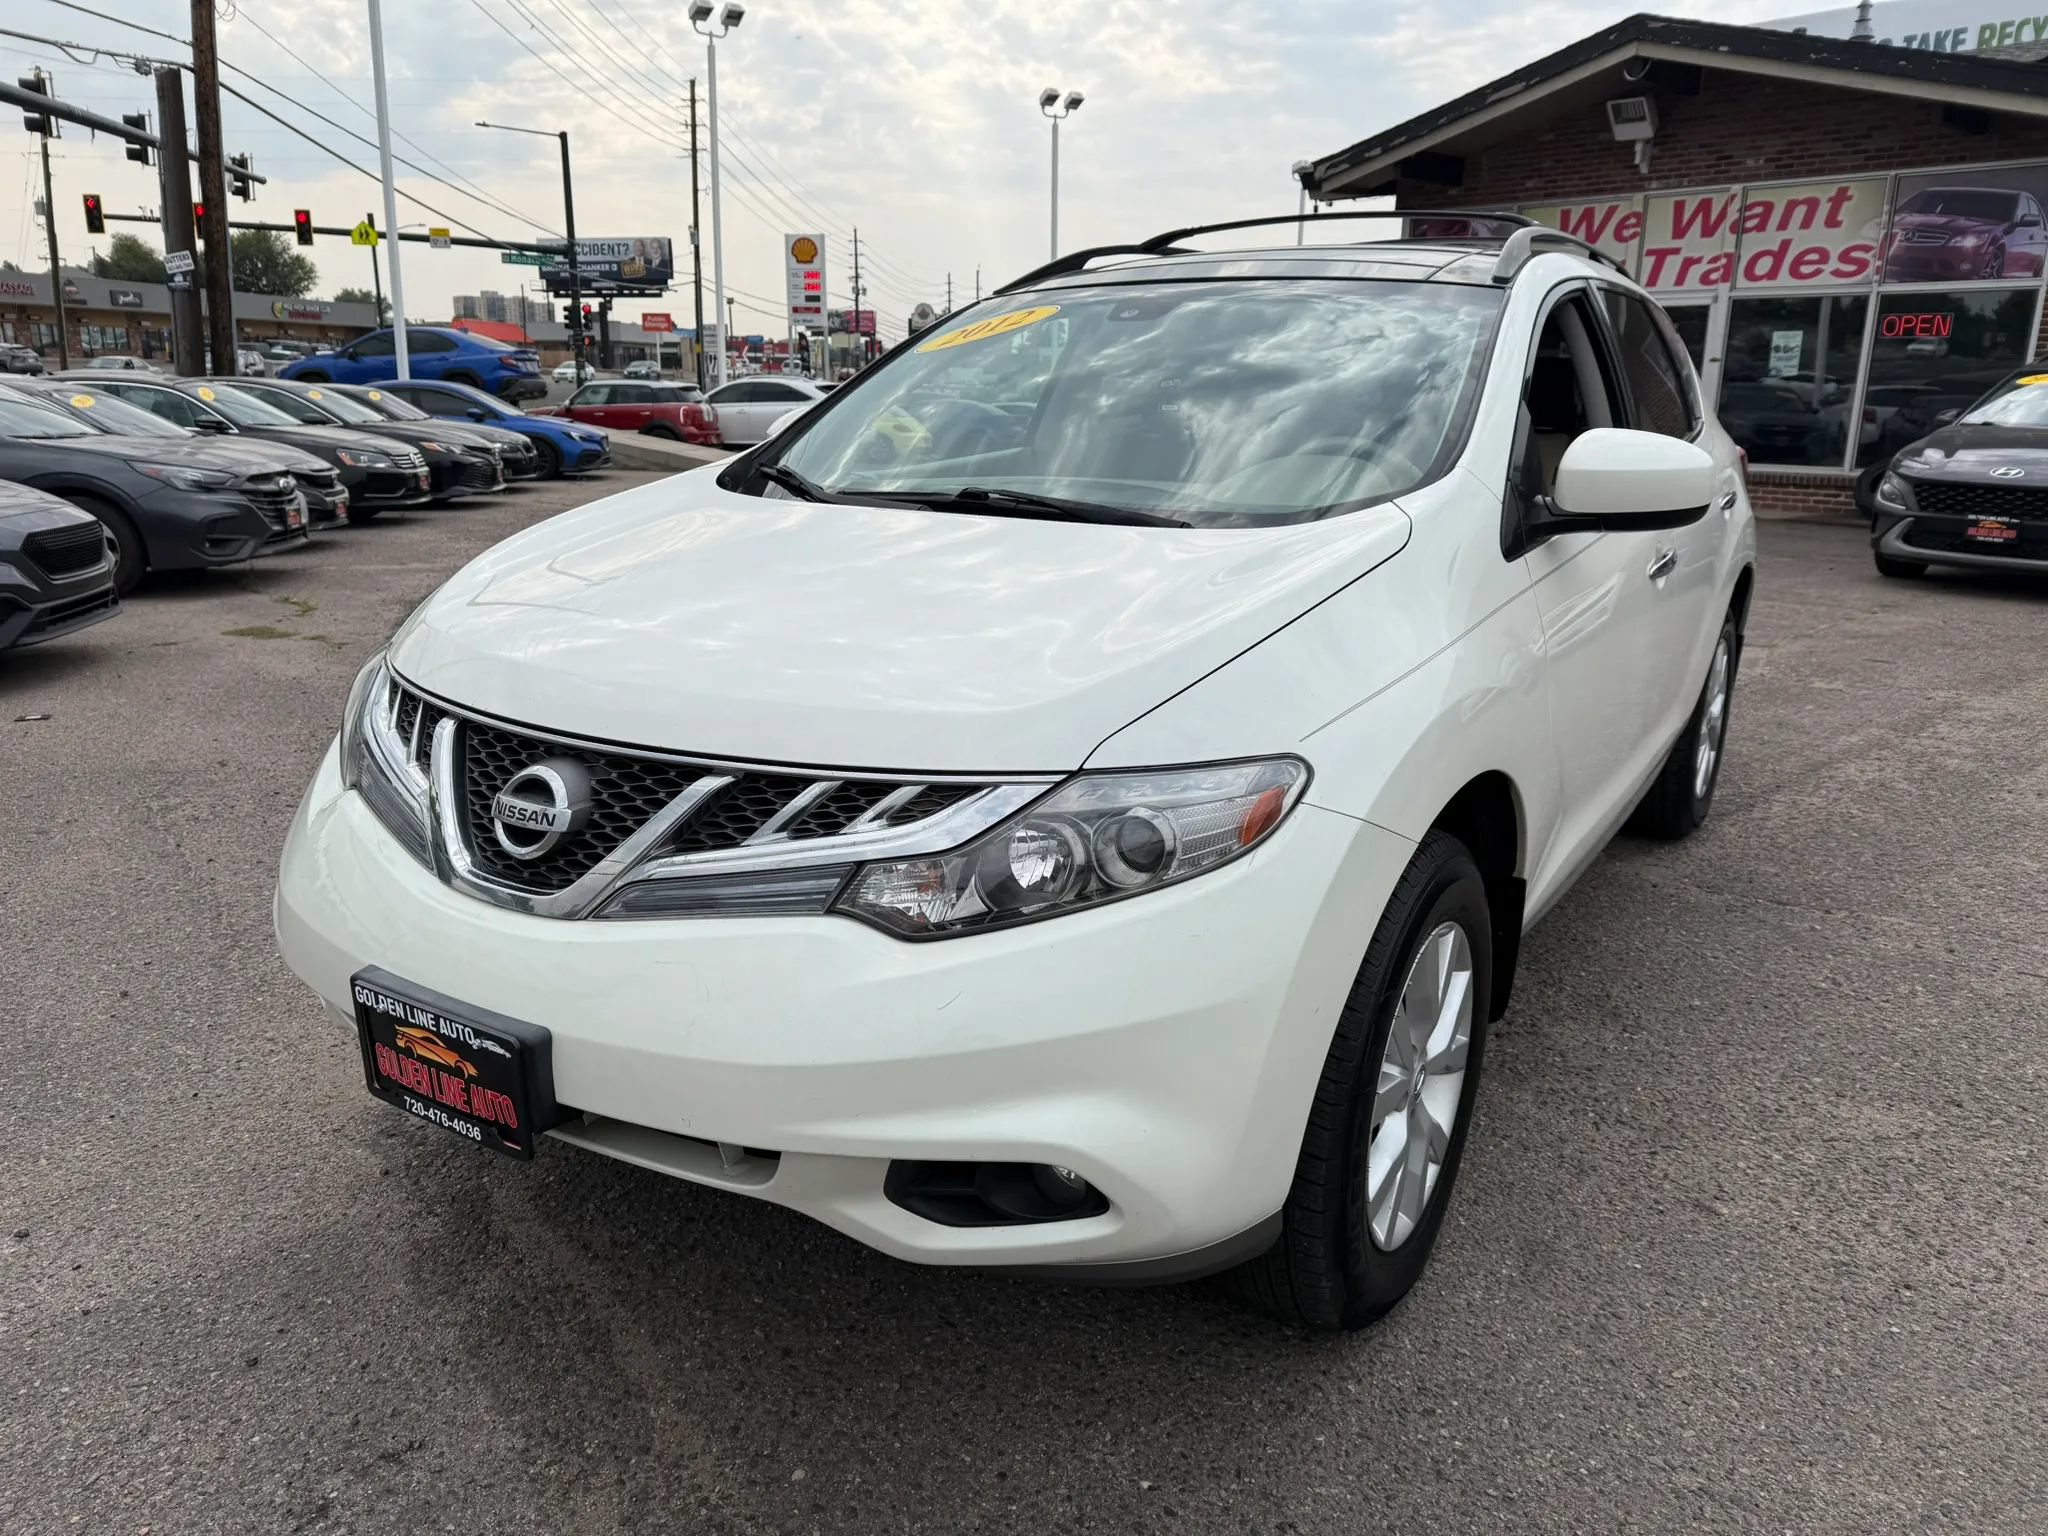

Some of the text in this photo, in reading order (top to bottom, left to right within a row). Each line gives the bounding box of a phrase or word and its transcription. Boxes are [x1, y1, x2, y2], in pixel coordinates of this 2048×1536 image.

[1904, 27, 1968, 52] TAKE
[1559, 186, 1853, 244] We Want
[574, 242, 630, 256] CCIDENT?
[936, 310, 1036, 347] 2012
[1882, 314, 1952, 337] OPEN
[494, 800, 557, 827] NISSAN
[355, 986, 475, 1046] GOLDEN LINE AUTO
[375, 1042, 518, 1129] GOLDEN LINE AUTO
[404, 1096, 482, 1141] 720-476-4036
